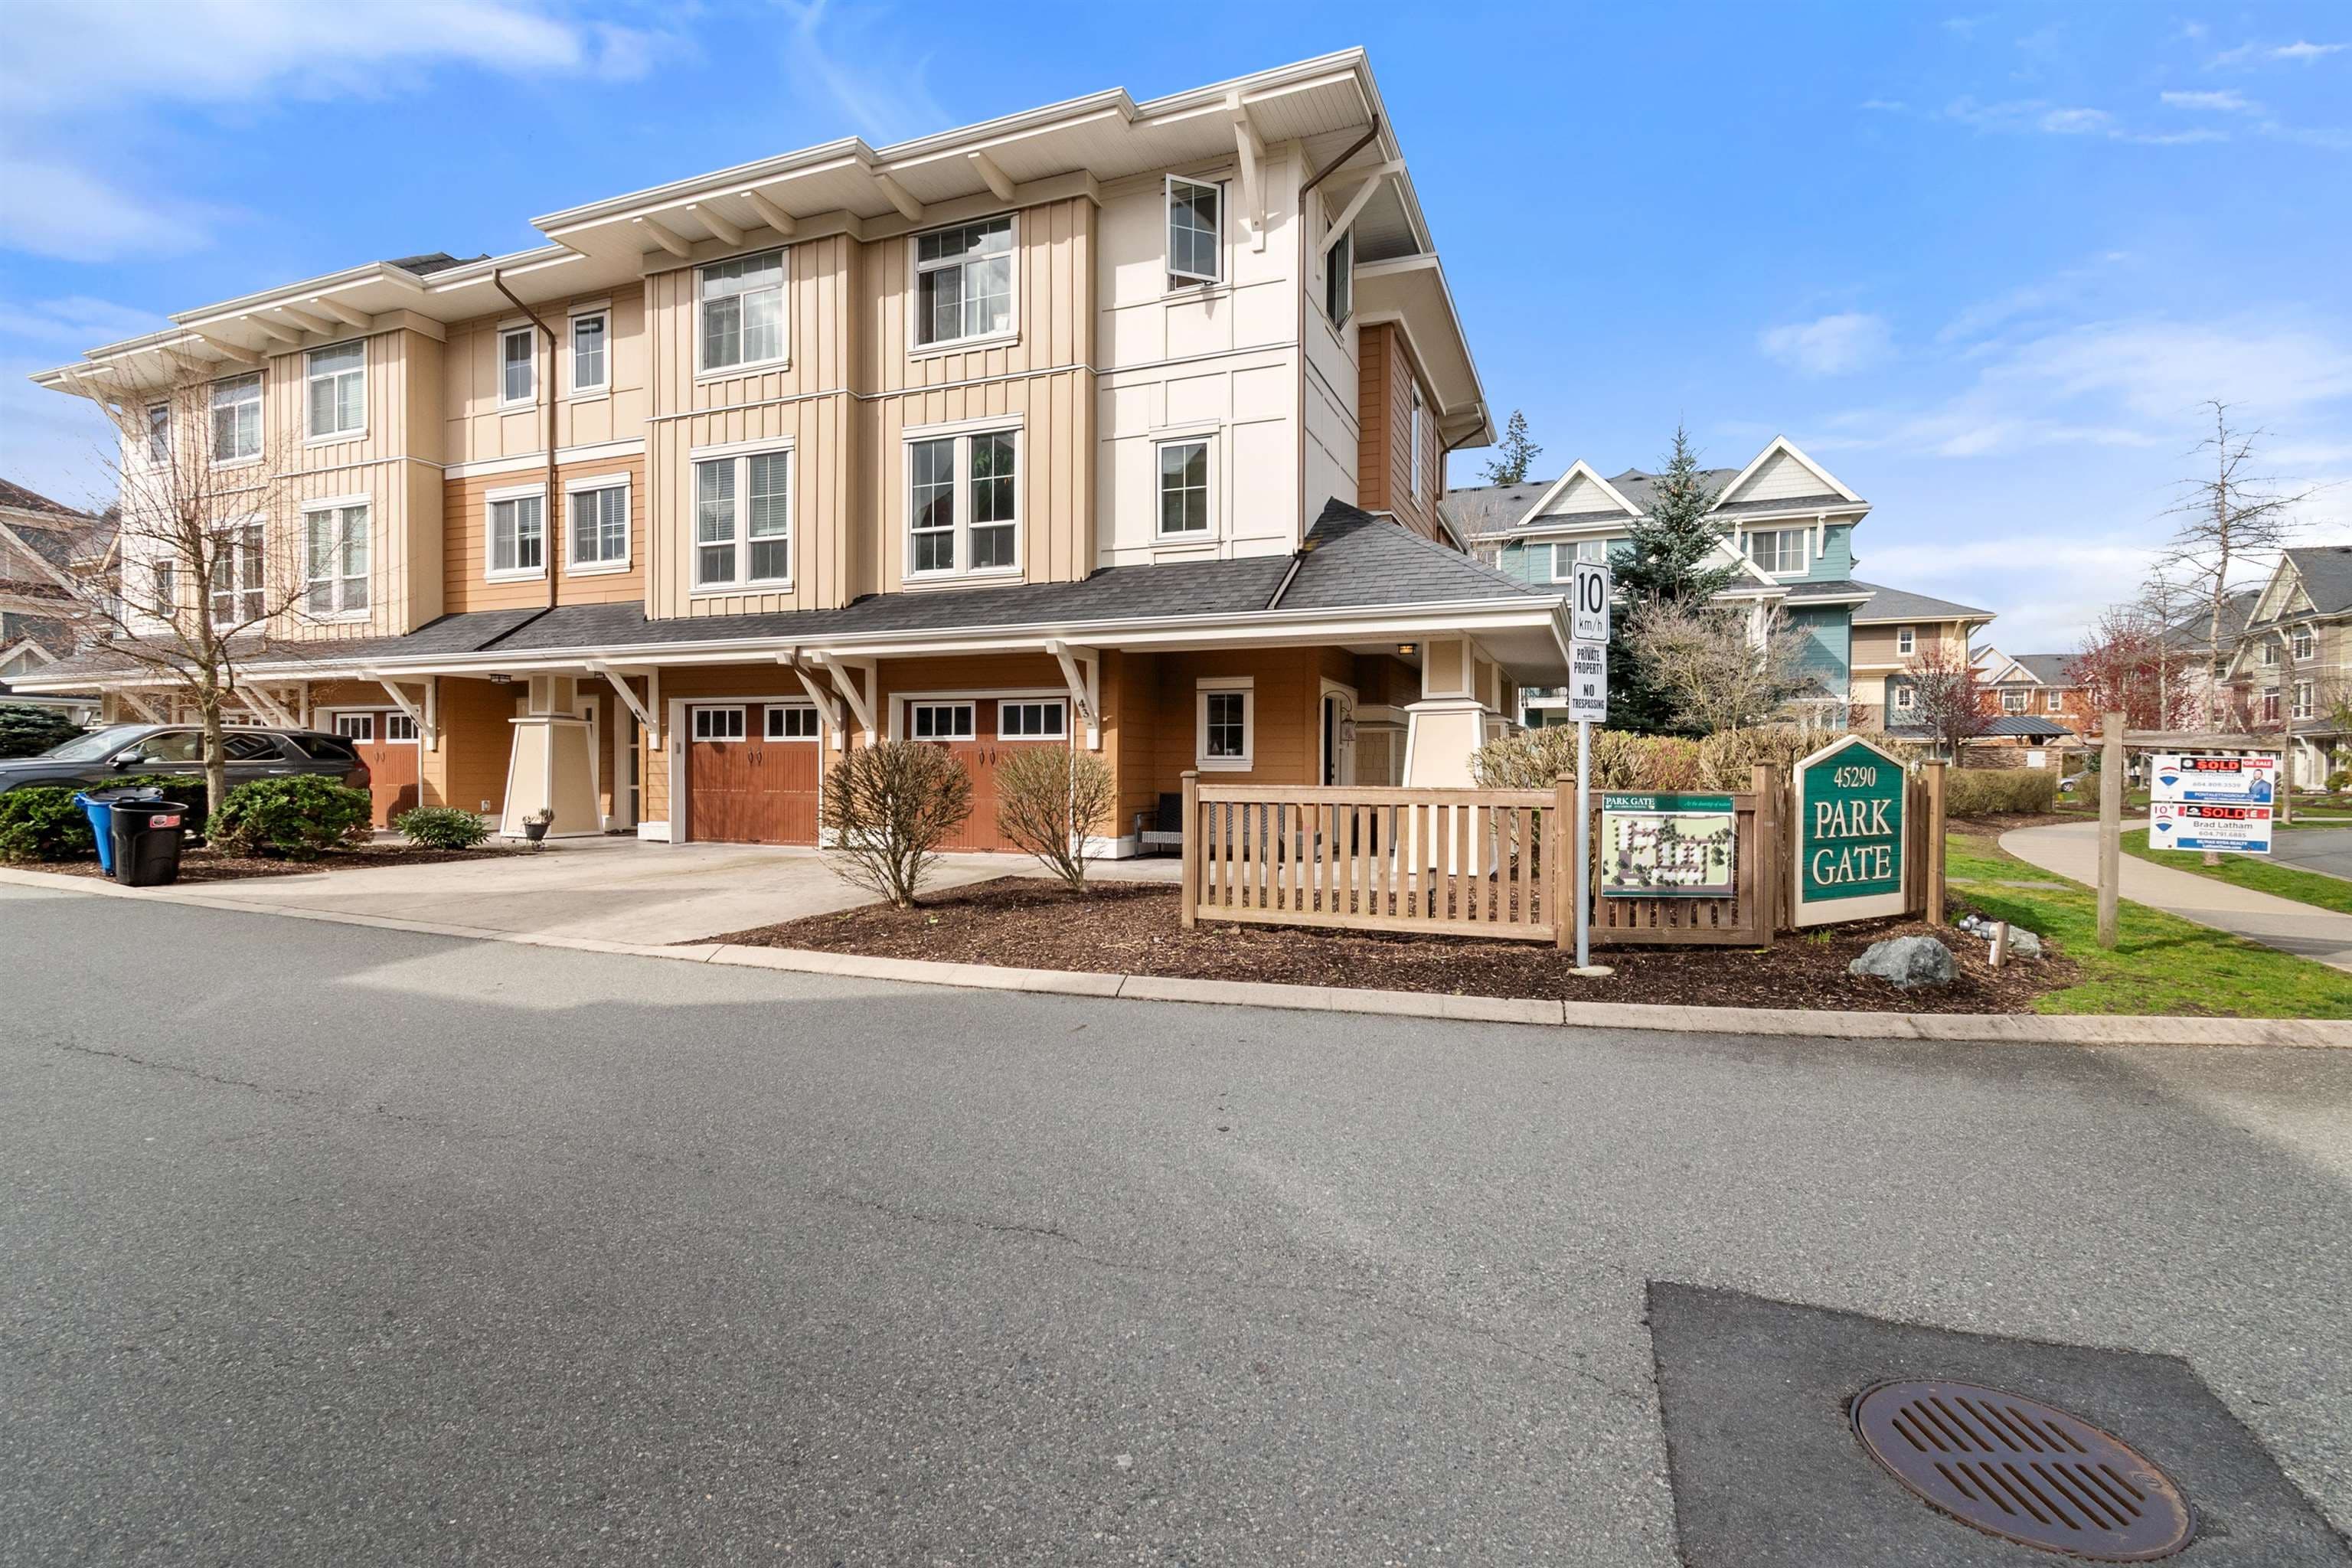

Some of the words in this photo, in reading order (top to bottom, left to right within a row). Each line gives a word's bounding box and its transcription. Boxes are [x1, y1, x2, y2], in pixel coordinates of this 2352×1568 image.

[1579, 572, 1603, 613] 10
[1579, 617, 1602, 632] km/h
[1576, 648, 1600, 662] PRIVATE
[1574, 662, 1602, 675] PROPERTY
[1583, 684, 1595, 697] NO
[1078, 698, 1089, 718] 43
[1573, 698, 1605, 710] TRESPASSING
[2197, 761, 2239, 769] SOLD
[1834, 766, 1876, 788] 45290
[1814, 799, 1893, 839] PARK
[2202, 807, 2245, 819] SOLD
[1812, 845, 1892, 885] GATE
